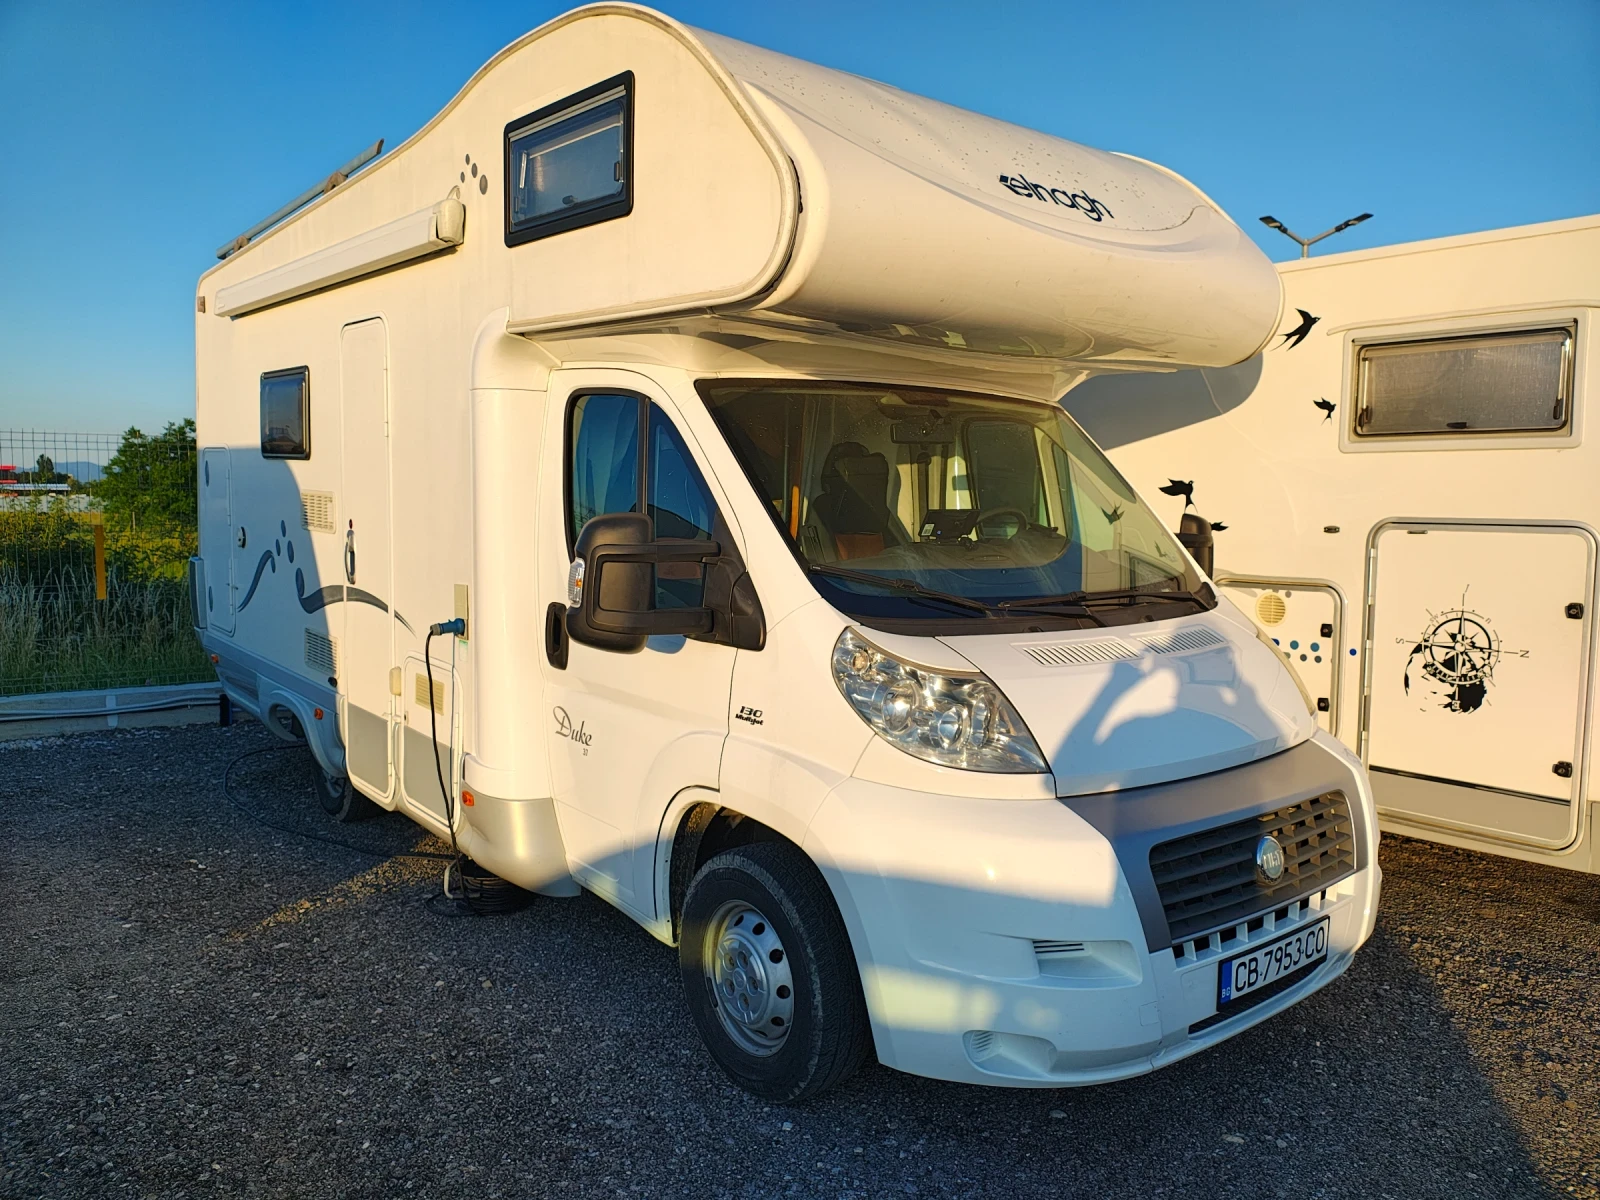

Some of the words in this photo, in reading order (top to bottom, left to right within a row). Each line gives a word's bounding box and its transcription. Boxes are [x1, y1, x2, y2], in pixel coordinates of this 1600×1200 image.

[740, 705, 763, 718] 130
[553, 705, 592, 746] Duke
[1221, 987, 1231, 998] BG
